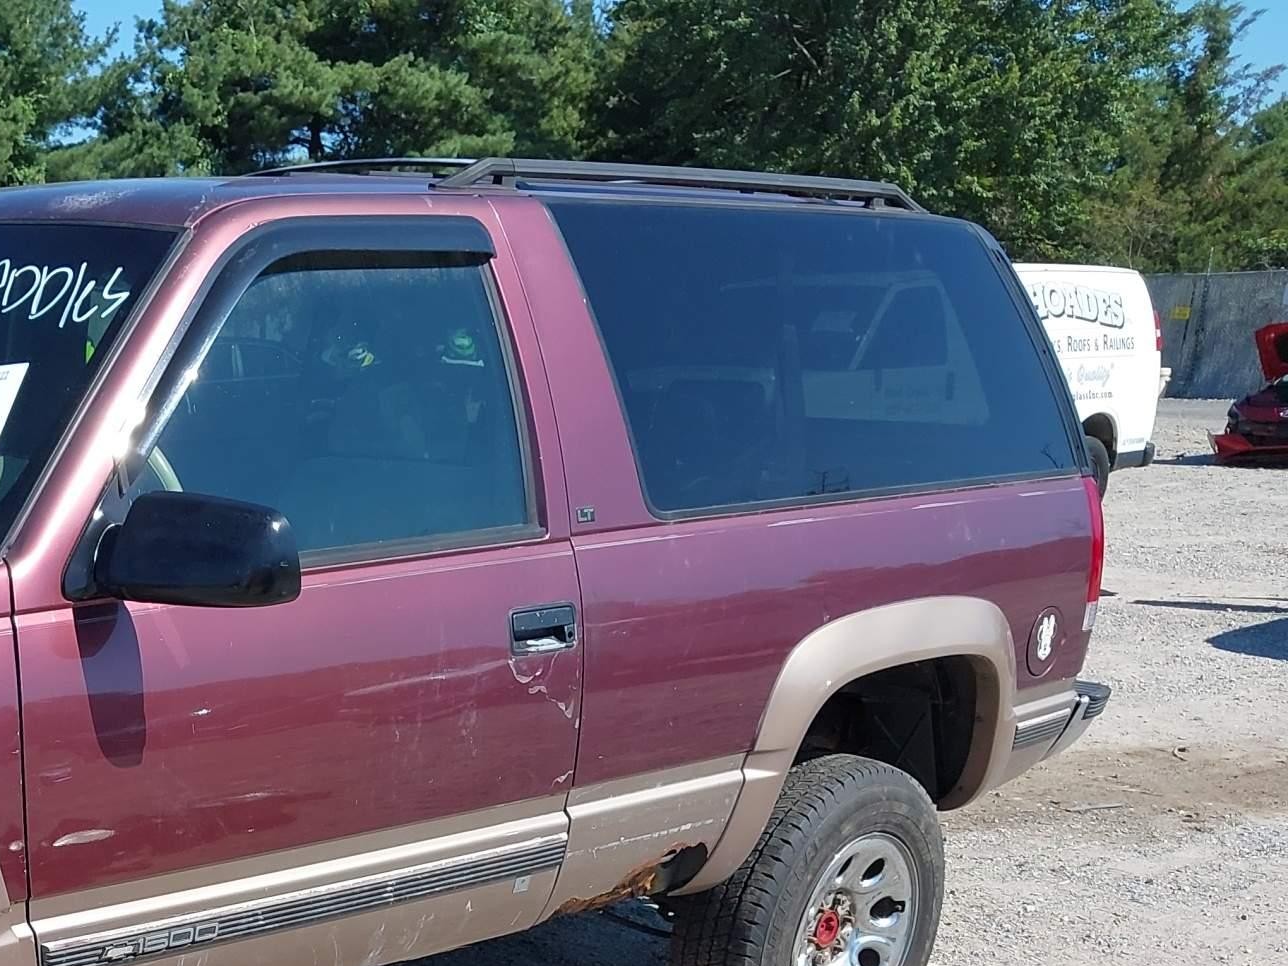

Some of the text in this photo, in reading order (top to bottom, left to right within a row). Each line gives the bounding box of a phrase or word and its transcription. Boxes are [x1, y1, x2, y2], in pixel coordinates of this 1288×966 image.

[1103, 334, 1135, 351] RAILINGS
[577, 508, 594, 522] LT
[139, 922, 219, 953] 1500
